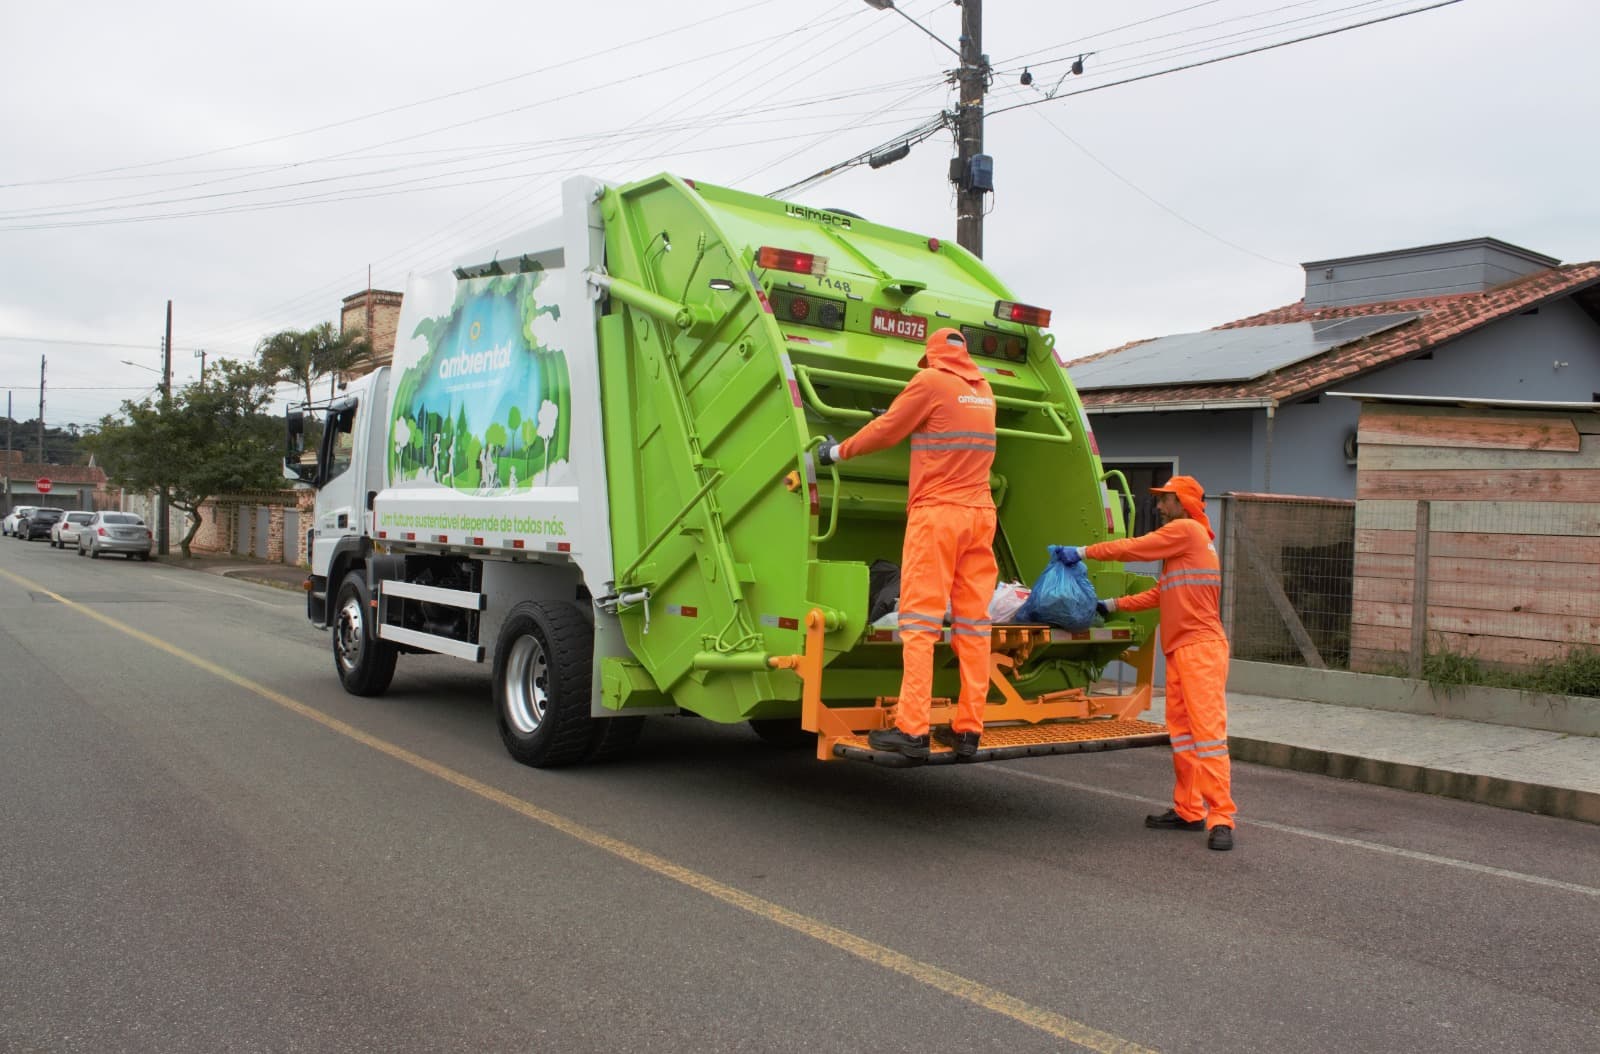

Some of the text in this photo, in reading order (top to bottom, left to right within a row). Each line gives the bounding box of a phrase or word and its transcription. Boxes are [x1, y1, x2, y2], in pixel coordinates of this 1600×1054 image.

[785, 203, 851, 227] usimeca
[814, 275, 852, 292] 7148
[897, 320, 926, 338] 0375
[439, 339, 511, 379] ambiental
[415, 511, 460, 530] sustentável
[461, 513, 499, 537] depende
[500, 514, 512, 532] de
[514, 515, 542, 534] todos
[544, 515, 566, 536] nós.
